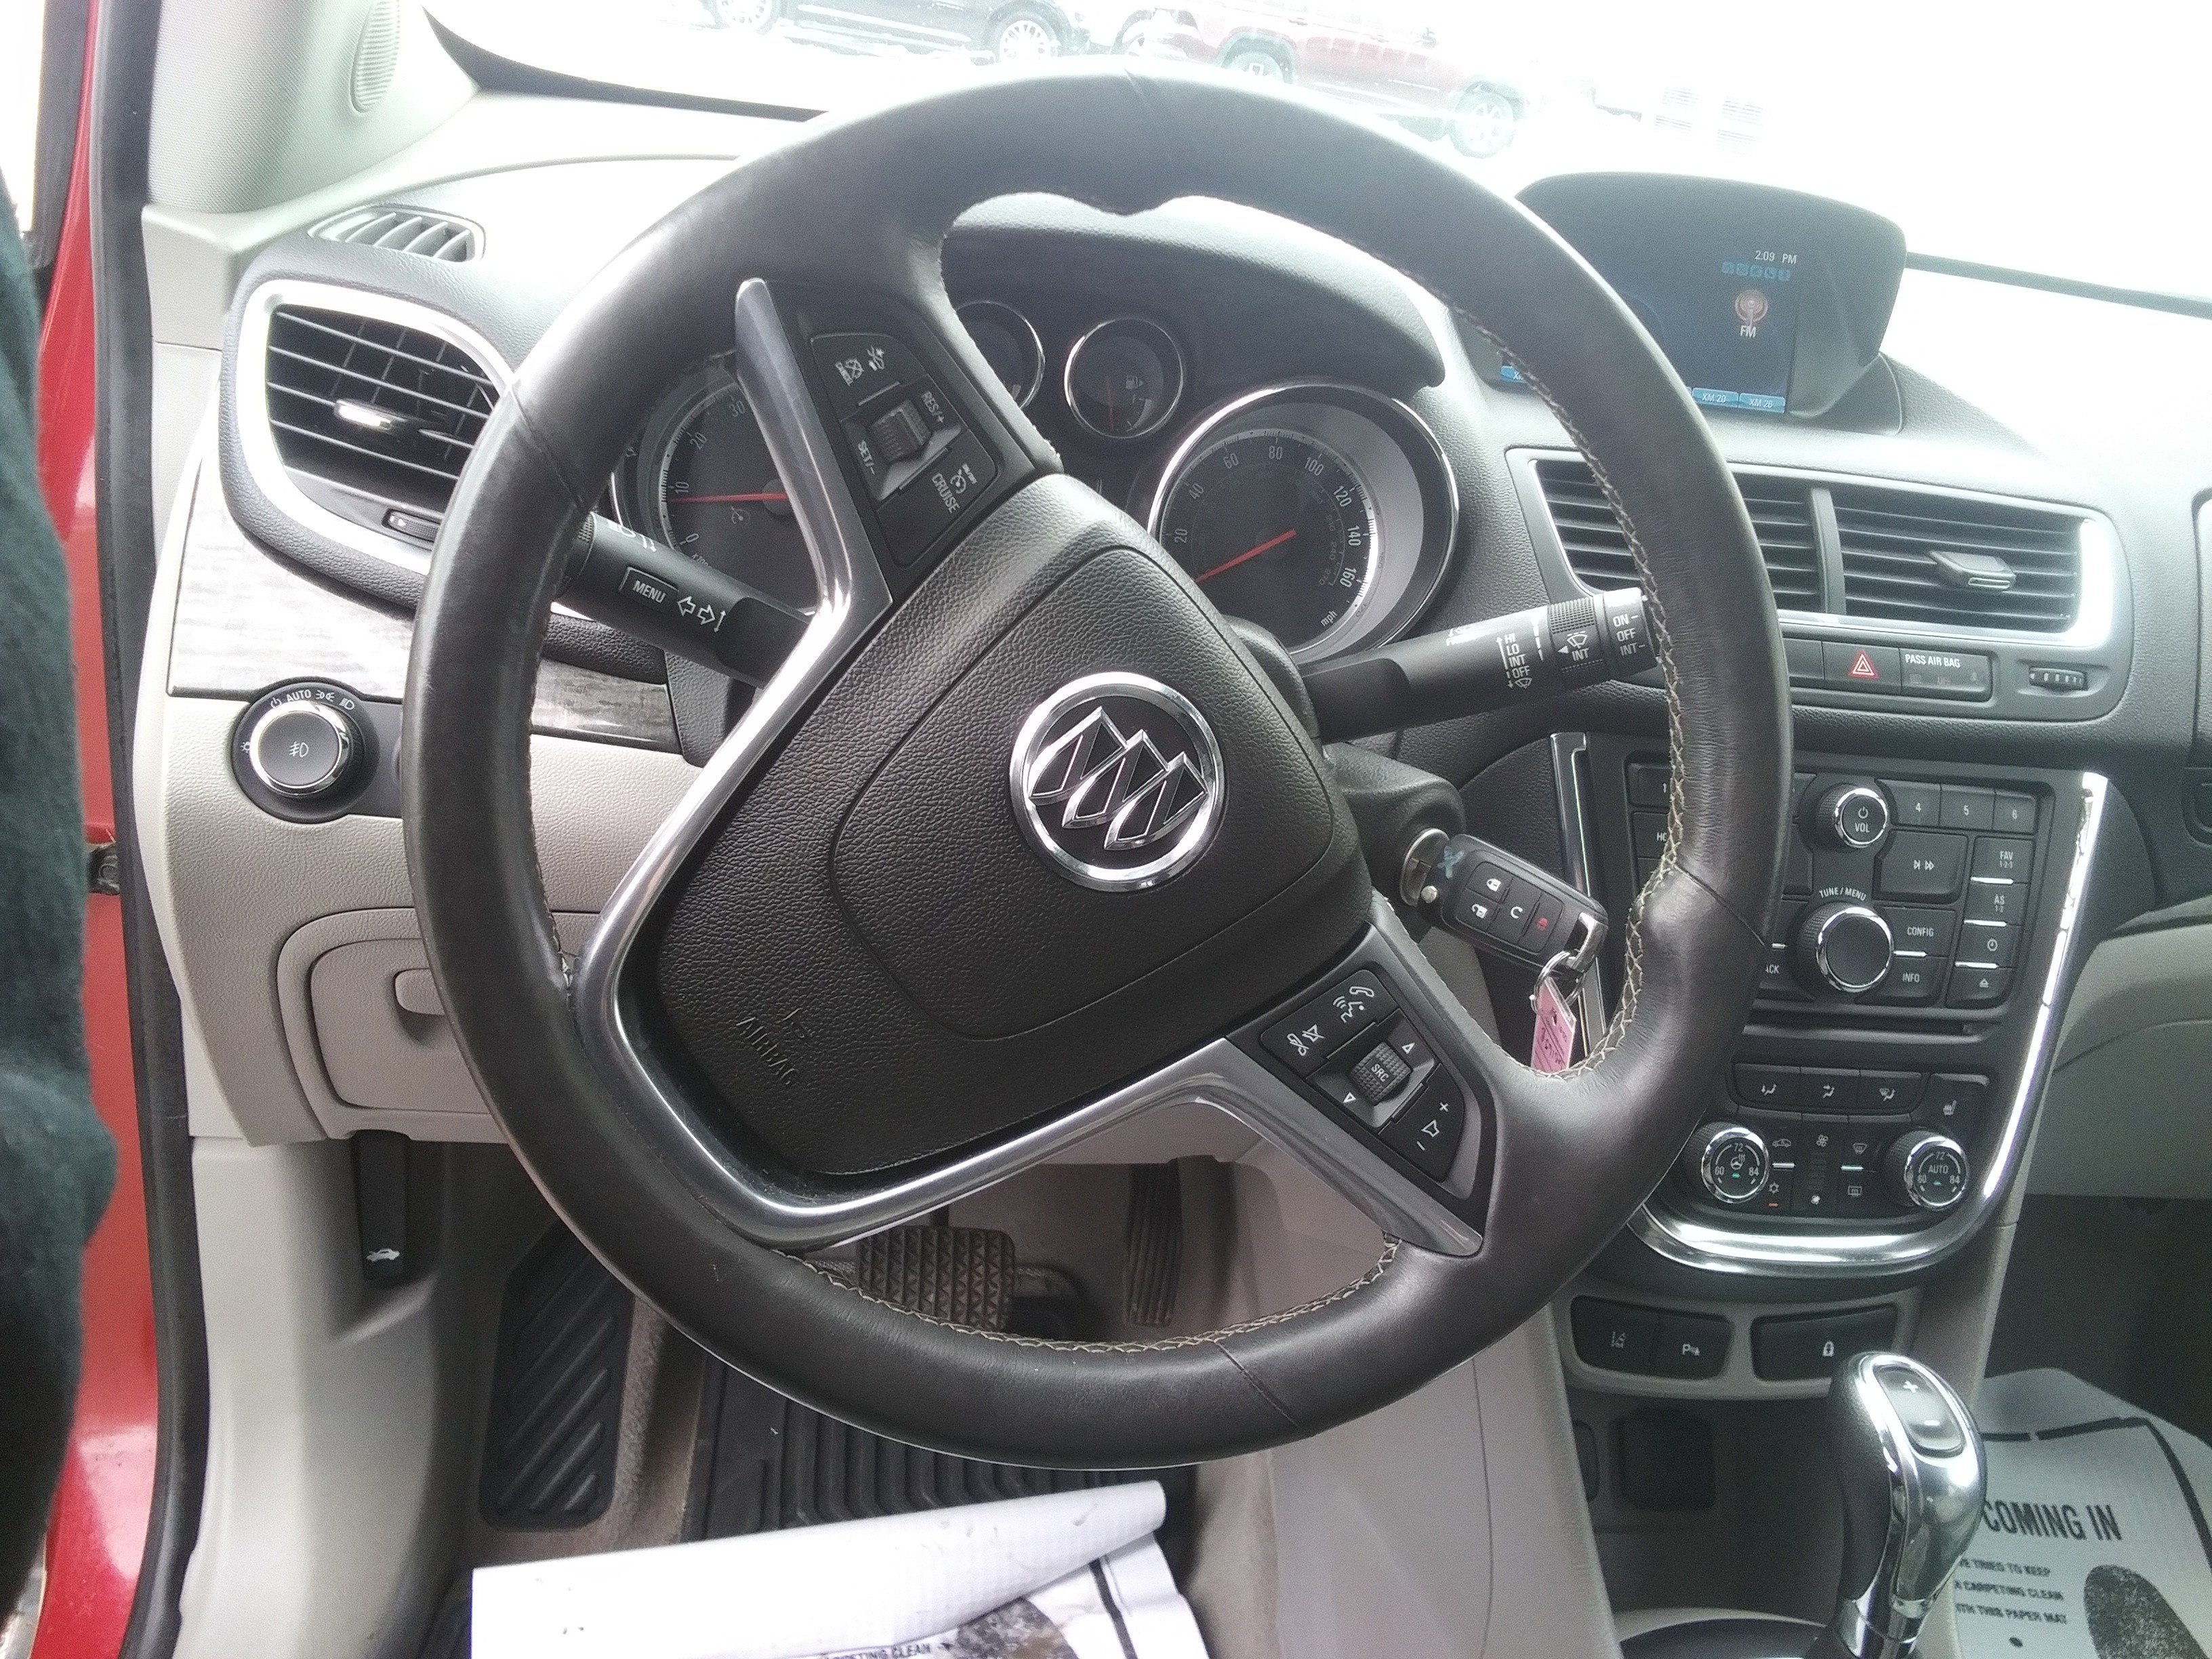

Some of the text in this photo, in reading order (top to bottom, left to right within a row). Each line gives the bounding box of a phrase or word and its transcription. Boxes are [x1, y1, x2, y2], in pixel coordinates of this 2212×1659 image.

[1782, 253, 1797, 264] PM
[1740, 325, 1757, 338] FM
[1702, 392, 1715, 402] XM
[1749, 398, 1762, 407] XM
[729, 400, 746, 417] 30
[690, 432, 708, 451] 20
[1268, 446, 1284, 461] 80
[1223, 453, 1240, 470] 60
[1303, 456, 1325, 476] 100
[674, 481, 690, 494] 10
[932, 472, 960, 514] CRUISE
[1188, 483, 1205, 501] 40
[1333, 485, 1352, 508] 120
[685, 533, 700, 543] 0
[1174, 528, 1189, 544] 20
[1347, 525, 1361, 547] 140
[1339, 567, 1357, 588] 160
[632, 580, 667, 604] MENU
[1321, 609, 1338, 628] mph
[1504, 632, 1515, 644] HI
[1616, 628, 1637, 642] OFF
[1506, 643, 1520, 655] LO
[1572, 648, 1590, 662] INT
[1509, 654, 1526, 667] INT
[1905, 653, 1961, 669] PASS AIR BAG
[286, 689, 312, 703] AUTO
[1915, 802, 1922, 813] 4
[1963, 805, 1969, 816] 5
[2011, 809, 2018, 820] 6
[1855, 822, 1870, 833] VOL
[2000, 851, 2014, 861] FAV
[1818, 886, 1839, 899] TUNE
[1845, 886, 1867, 901] MENU
[1994, 895, 2005, 905] AS
[1907, 926, 1935, 937] CONFIG
[1902, 972, 1921, 983] INFO
[1371, 1063, 1389, 1082] SRC
[1734, 1143, 1744, 1152] 72
[1715, 1166, 1759, 1176] 60 84
[1928, 1164, 1949, 1174] AUTO
[1949, 1174, 1961, 1185] 84
[1982, 1500, 2123, 1542] COMING IN
[2005, 1607, 2043, 1622] PAPER
